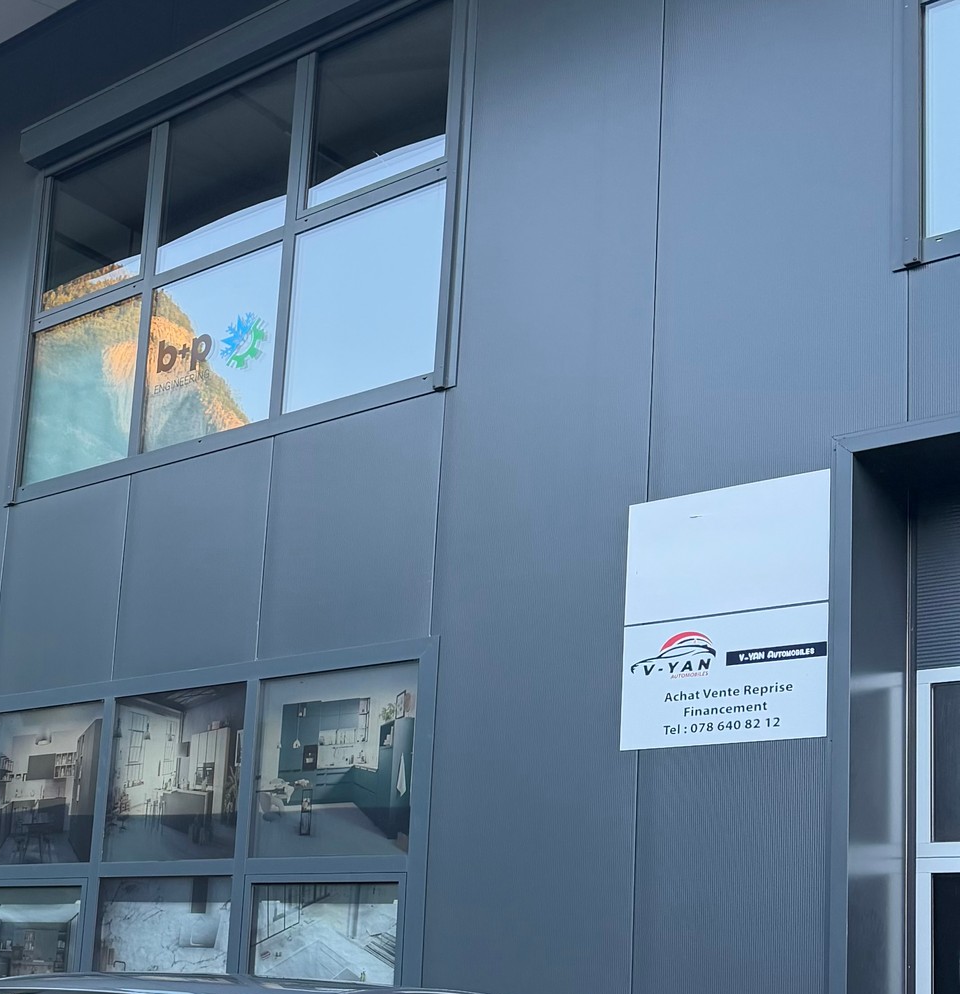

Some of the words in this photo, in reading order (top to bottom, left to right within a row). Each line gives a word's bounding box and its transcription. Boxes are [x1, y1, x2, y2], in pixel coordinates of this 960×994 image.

[156, 333, 213, 374] b+p
[153, 368, 210, 395] ENGINEERING
[738, 651, 765, 662] V-YAN
[643, 658, 711, 676] V-YAN
[670, 671, 709, 680] AUTOMOBILES
[664, 690, 700, 703] Achat
[703, 687, 740, 699] Vente
[743, 681, 794, 699] Reprise
[683, 701, 768, 717] Financement
[690, 721, 714, 734] 078
[717, 719, 741, 732] 640
[744, 718, 761, 729] 82
[765, 716, 781, 728] 12
